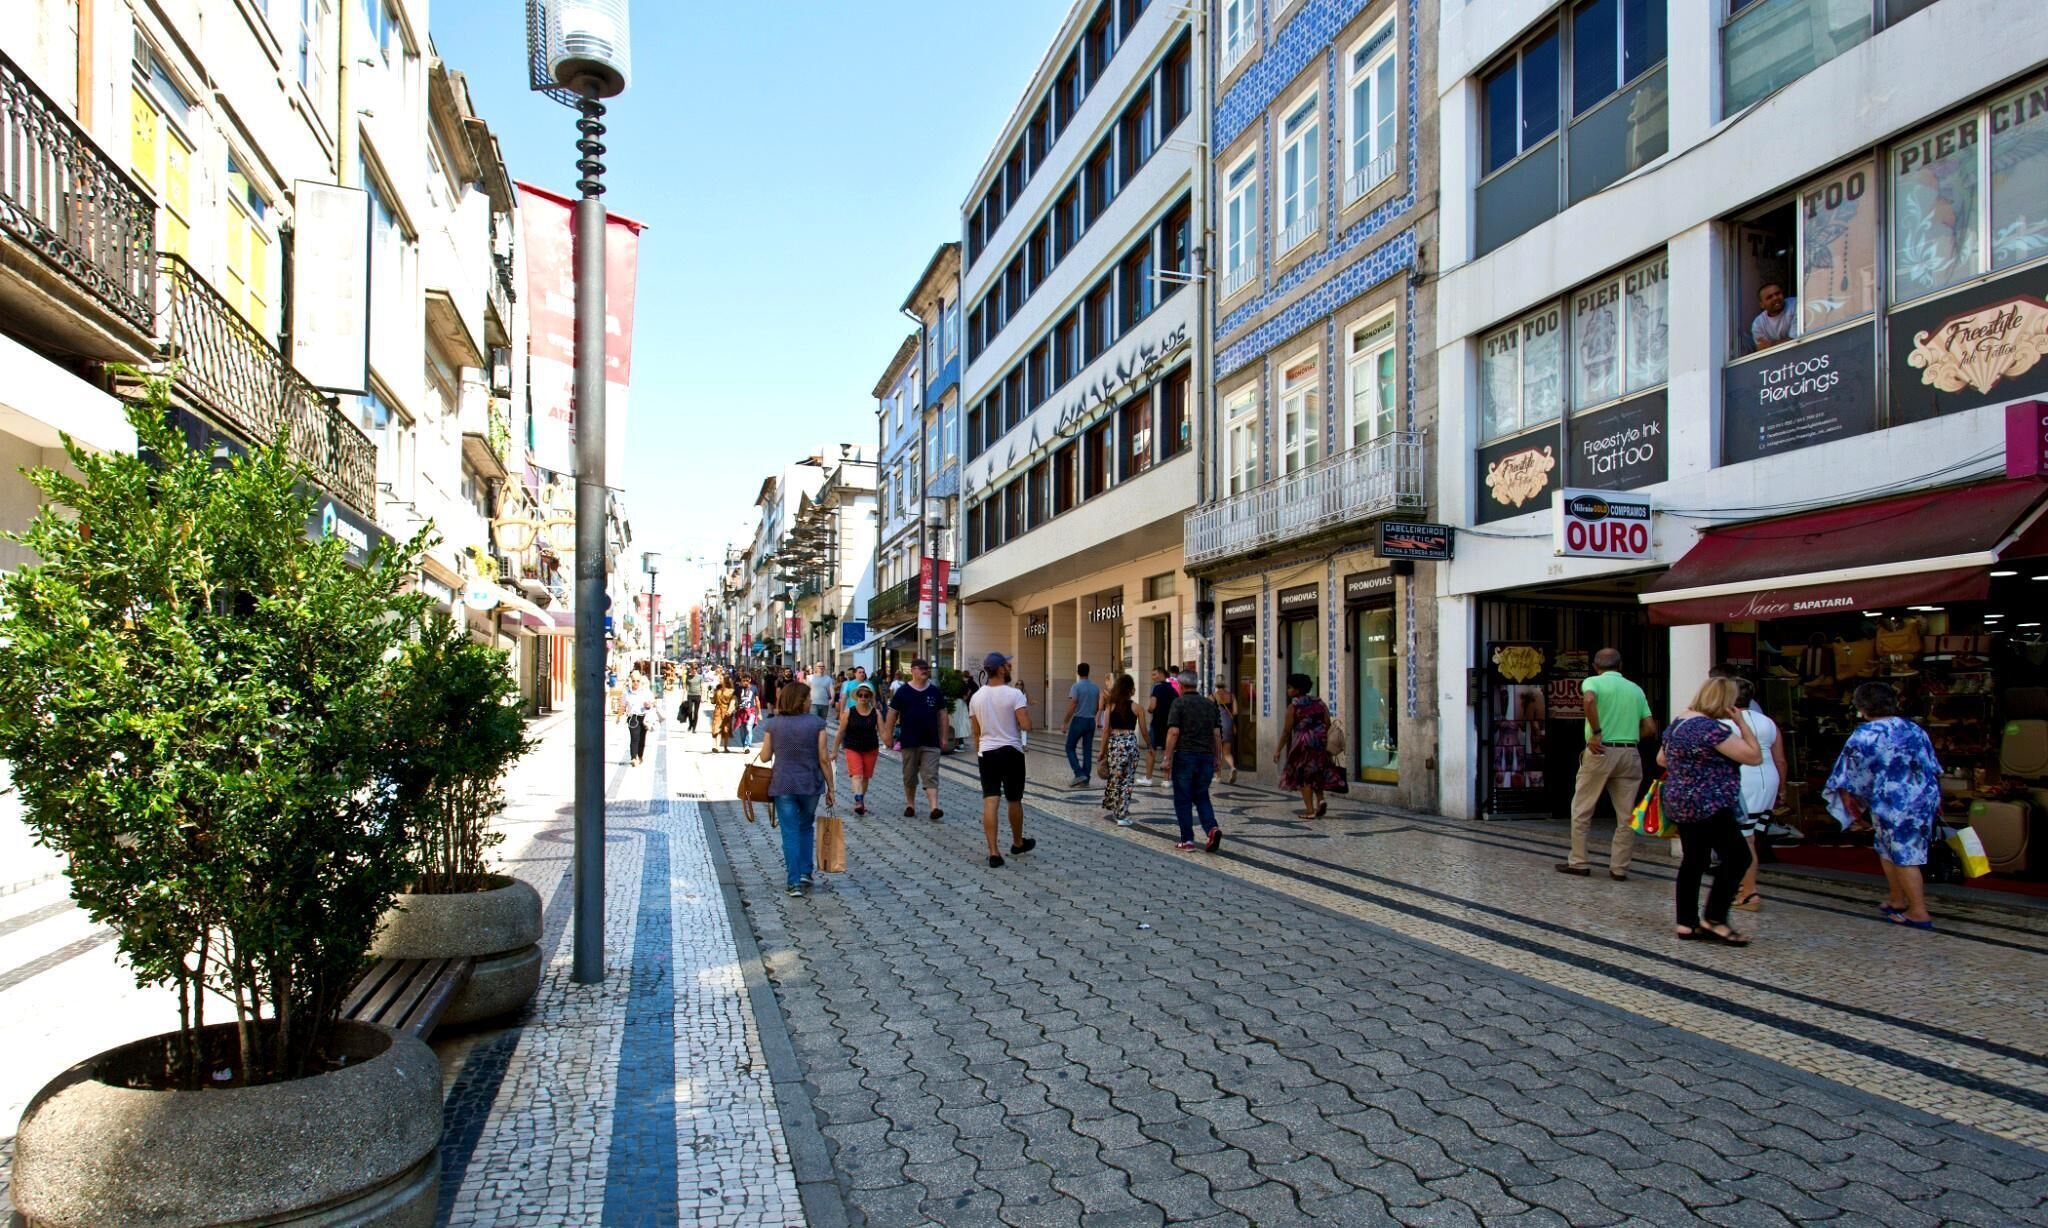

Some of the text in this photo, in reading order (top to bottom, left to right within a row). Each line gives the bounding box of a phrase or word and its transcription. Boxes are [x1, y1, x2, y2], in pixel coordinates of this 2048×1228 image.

[1945, 304, 2024, 352] Freestyle
[1759, 354, 1830, 386] Tattoos
[1760, 371, 1840, 406] Piercings
[1583, 420, 1661, 455] Freestyle Ink
[1587, 443, 1654, 475] Tattoo
[1610, 504, 1647, 518] COMPRAMOS
[1385, 524, 1445, 536] CABELEIREIROS
[1567, 520, 1648, 554] OURO
[1281, 591, 1318, 605] PRONOVIAS
[1348, 576, 1393, 593] PRONOVIAS
[1088, 606, 1121, 624] TIFFOSI
[1225, 603, 1256, 616] PRONOVIAS
[1729, 591, 1854, 618] Naice SAPATARIA
